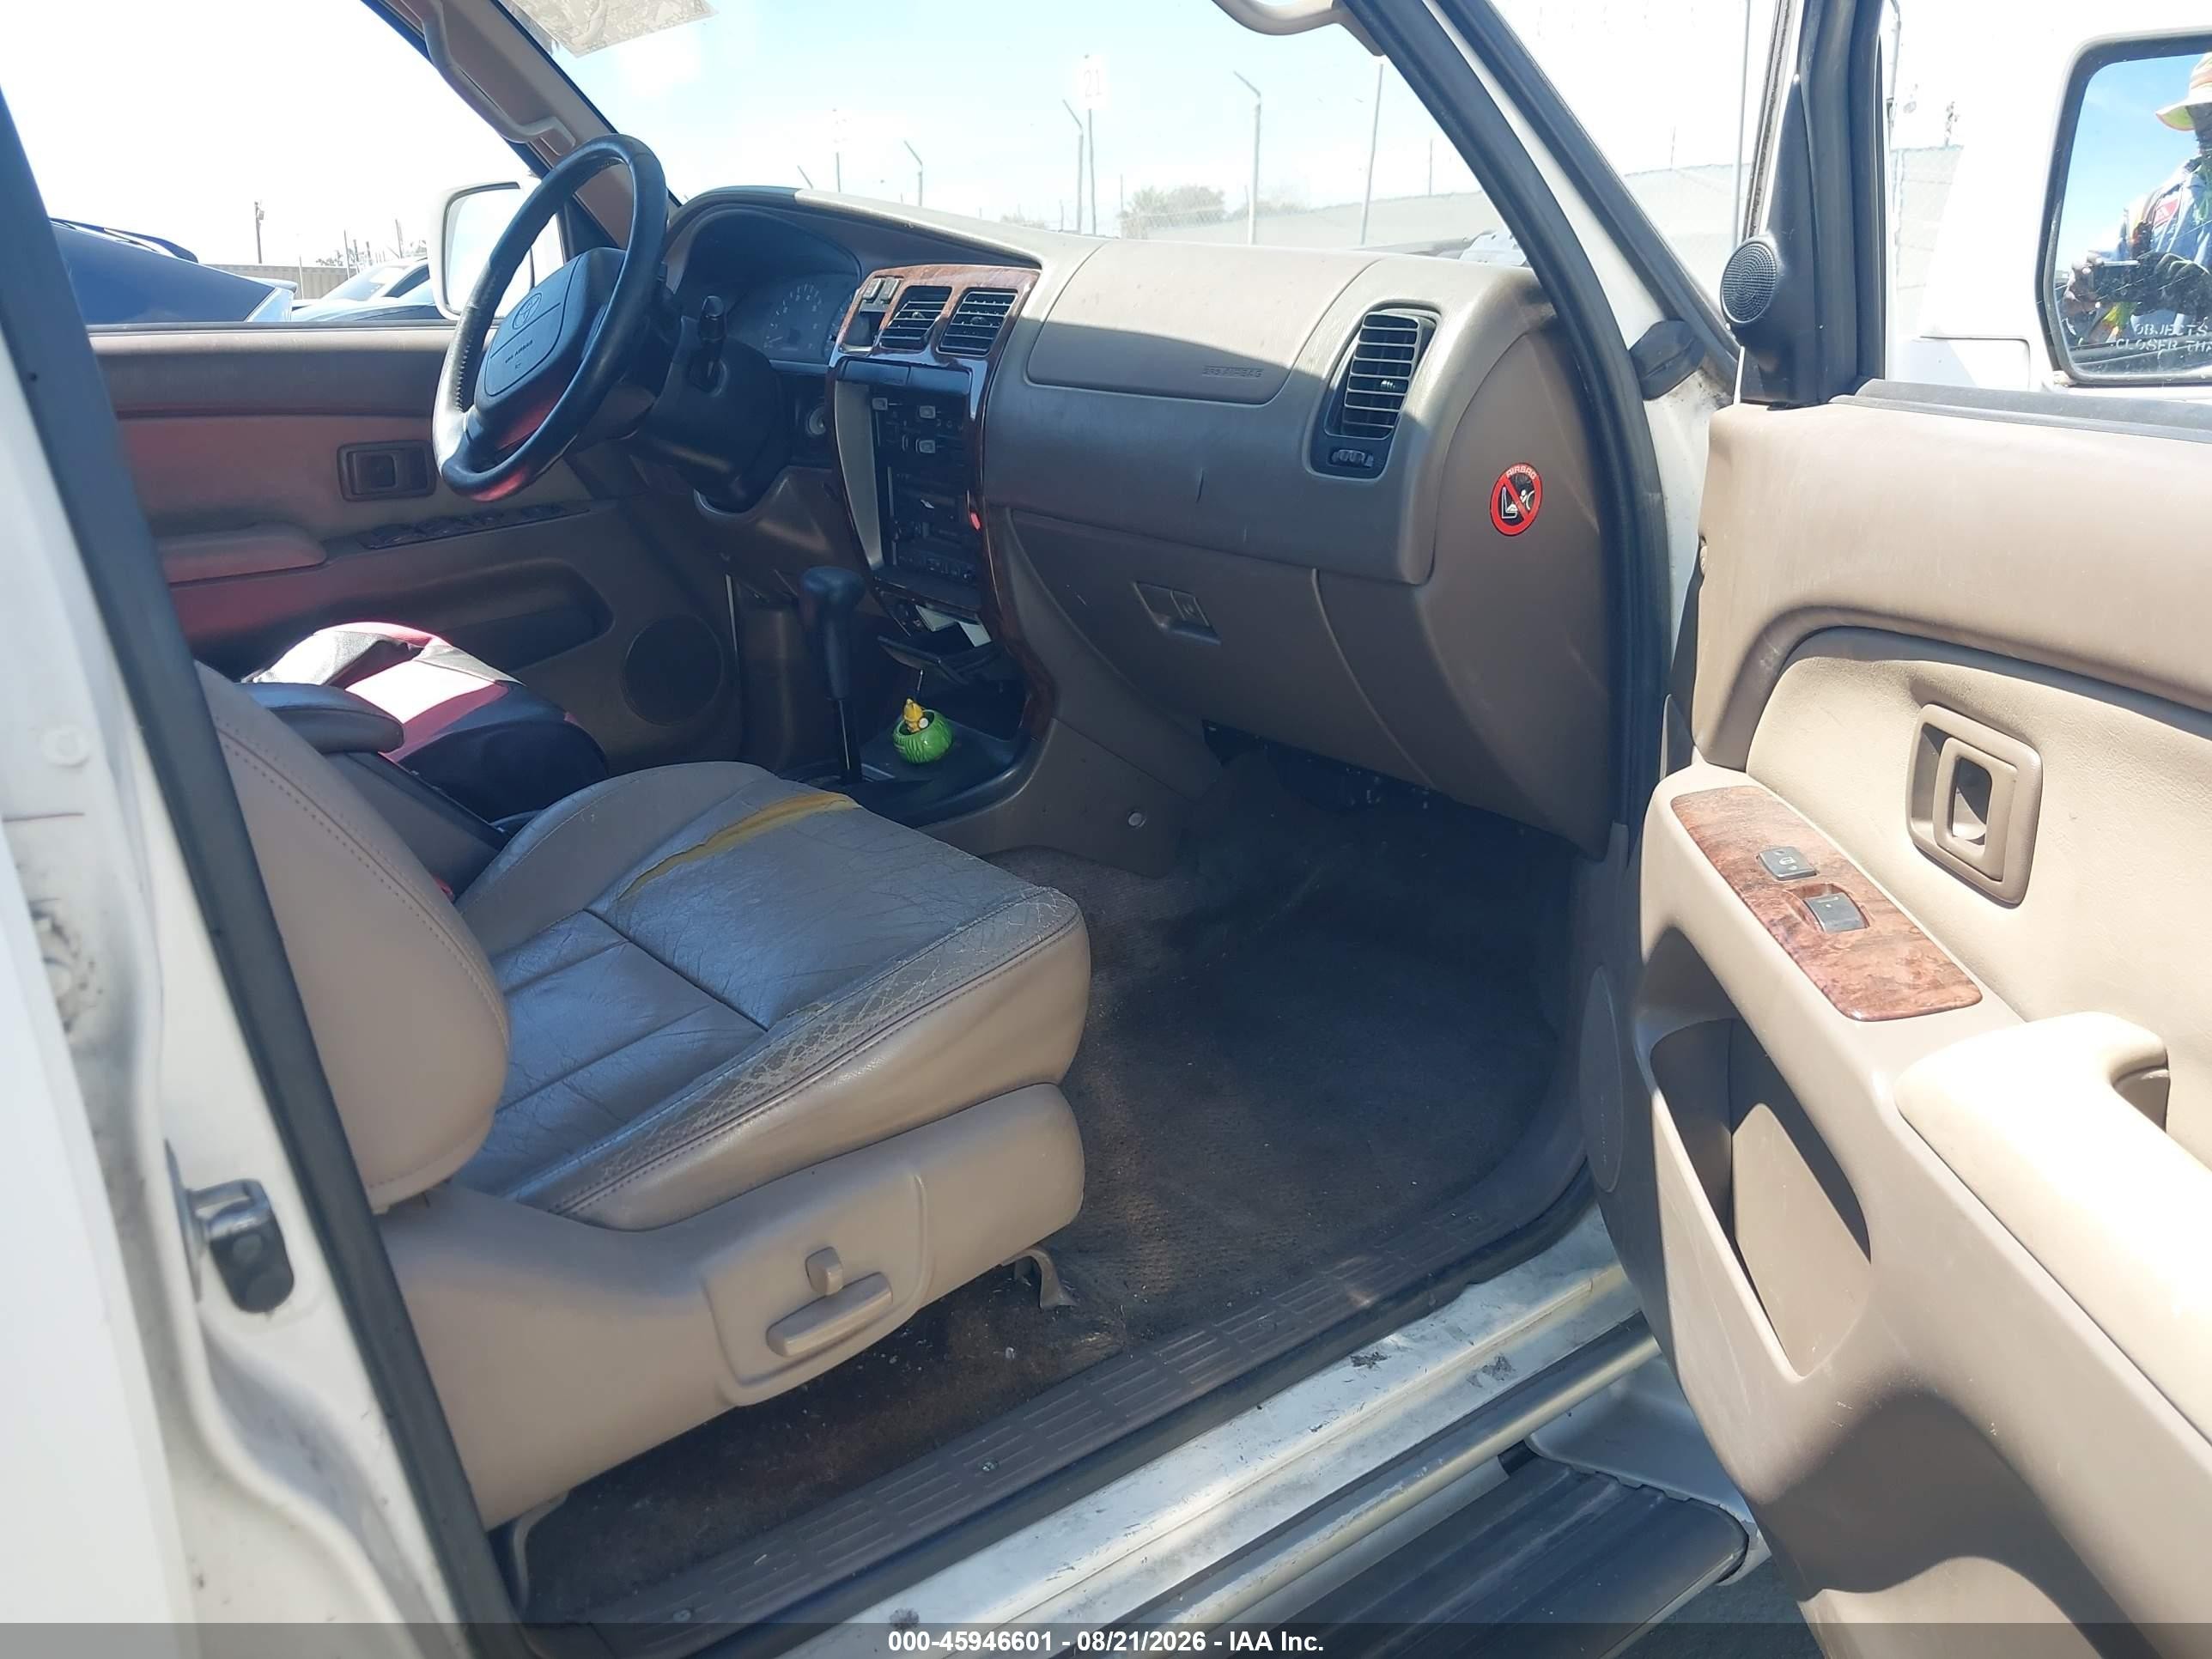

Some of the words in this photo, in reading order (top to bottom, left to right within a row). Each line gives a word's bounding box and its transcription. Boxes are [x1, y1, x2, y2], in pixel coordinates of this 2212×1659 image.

[1084, 69, 1103, 97] 21
[2135, 323, 2209, 337] OBJECTS
[2116, 338, 2179, 351] CLOSER
[1505, 465, 1538, 480] AIRBAG
